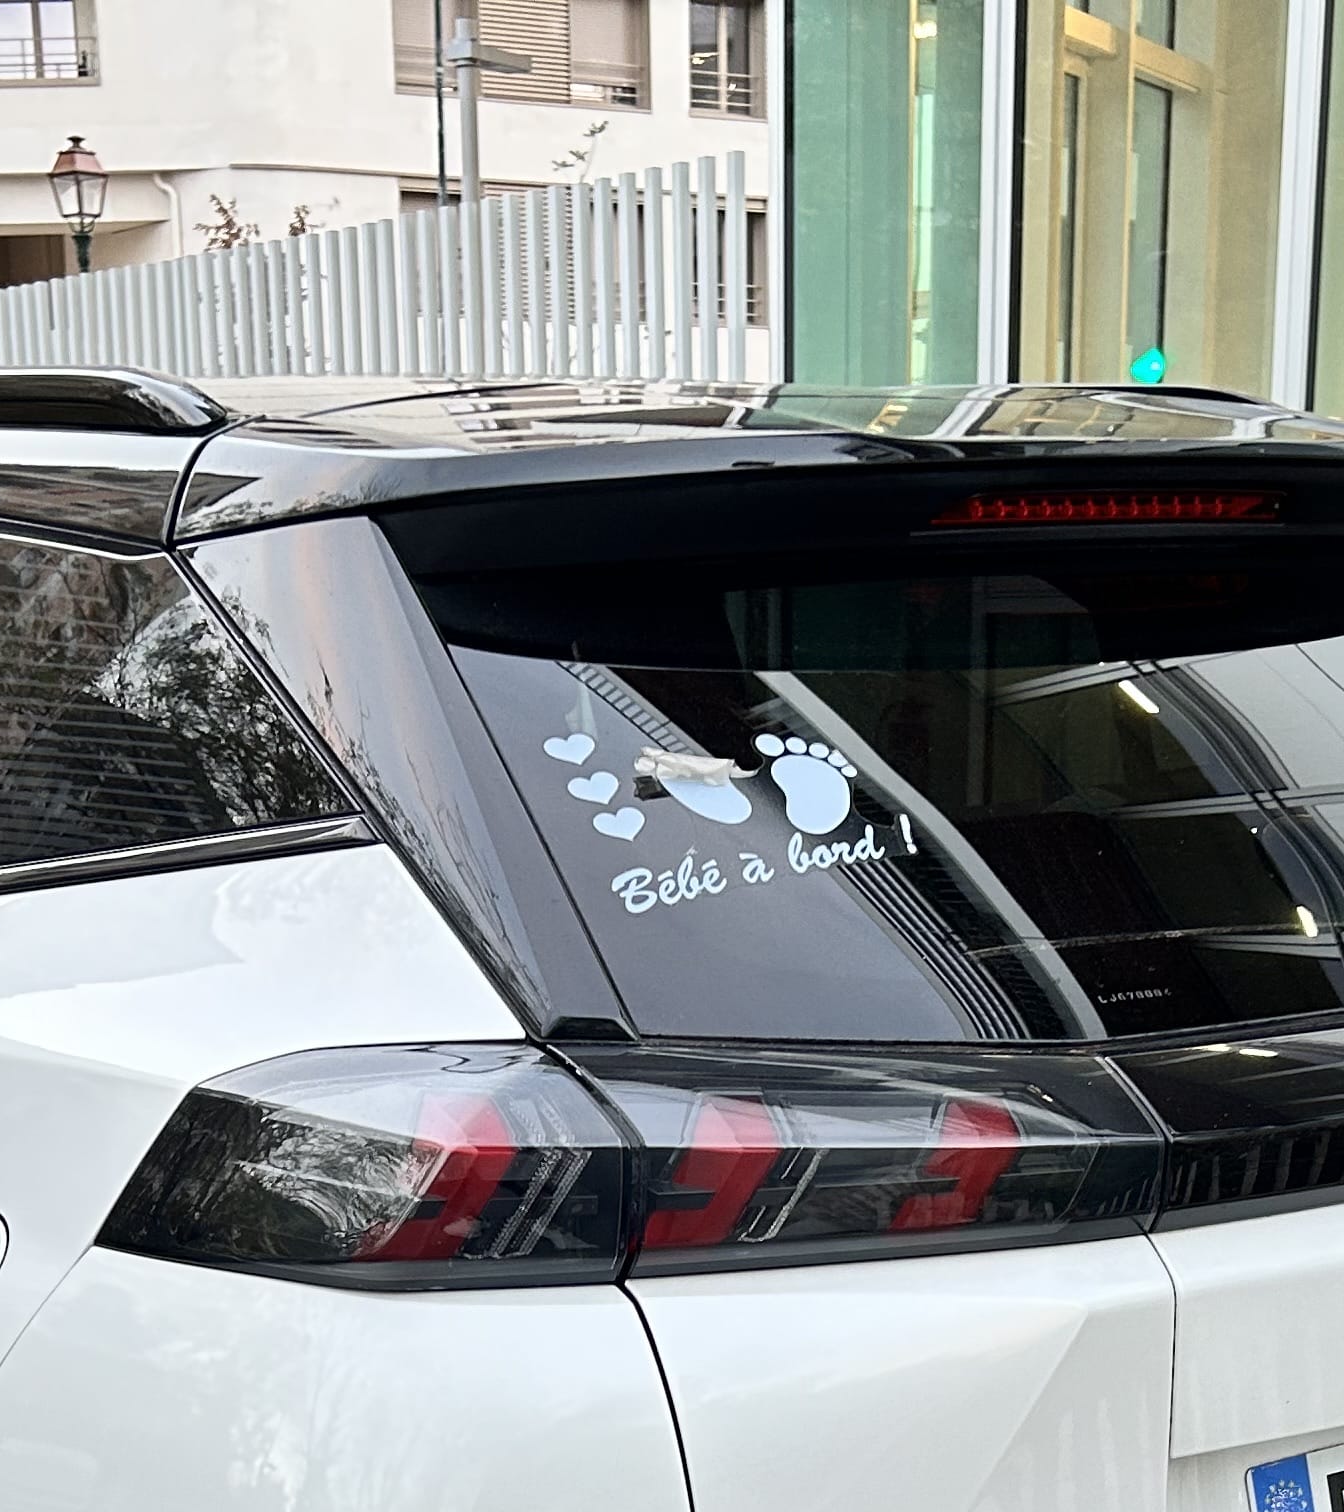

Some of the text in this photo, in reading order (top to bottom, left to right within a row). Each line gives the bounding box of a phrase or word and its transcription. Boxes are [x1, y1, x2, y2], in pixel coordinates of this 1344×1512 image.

[612, 851, 727, 914] Bébé
[739, 852, 774, 883] à
[788, 824, 885, 874] bord
